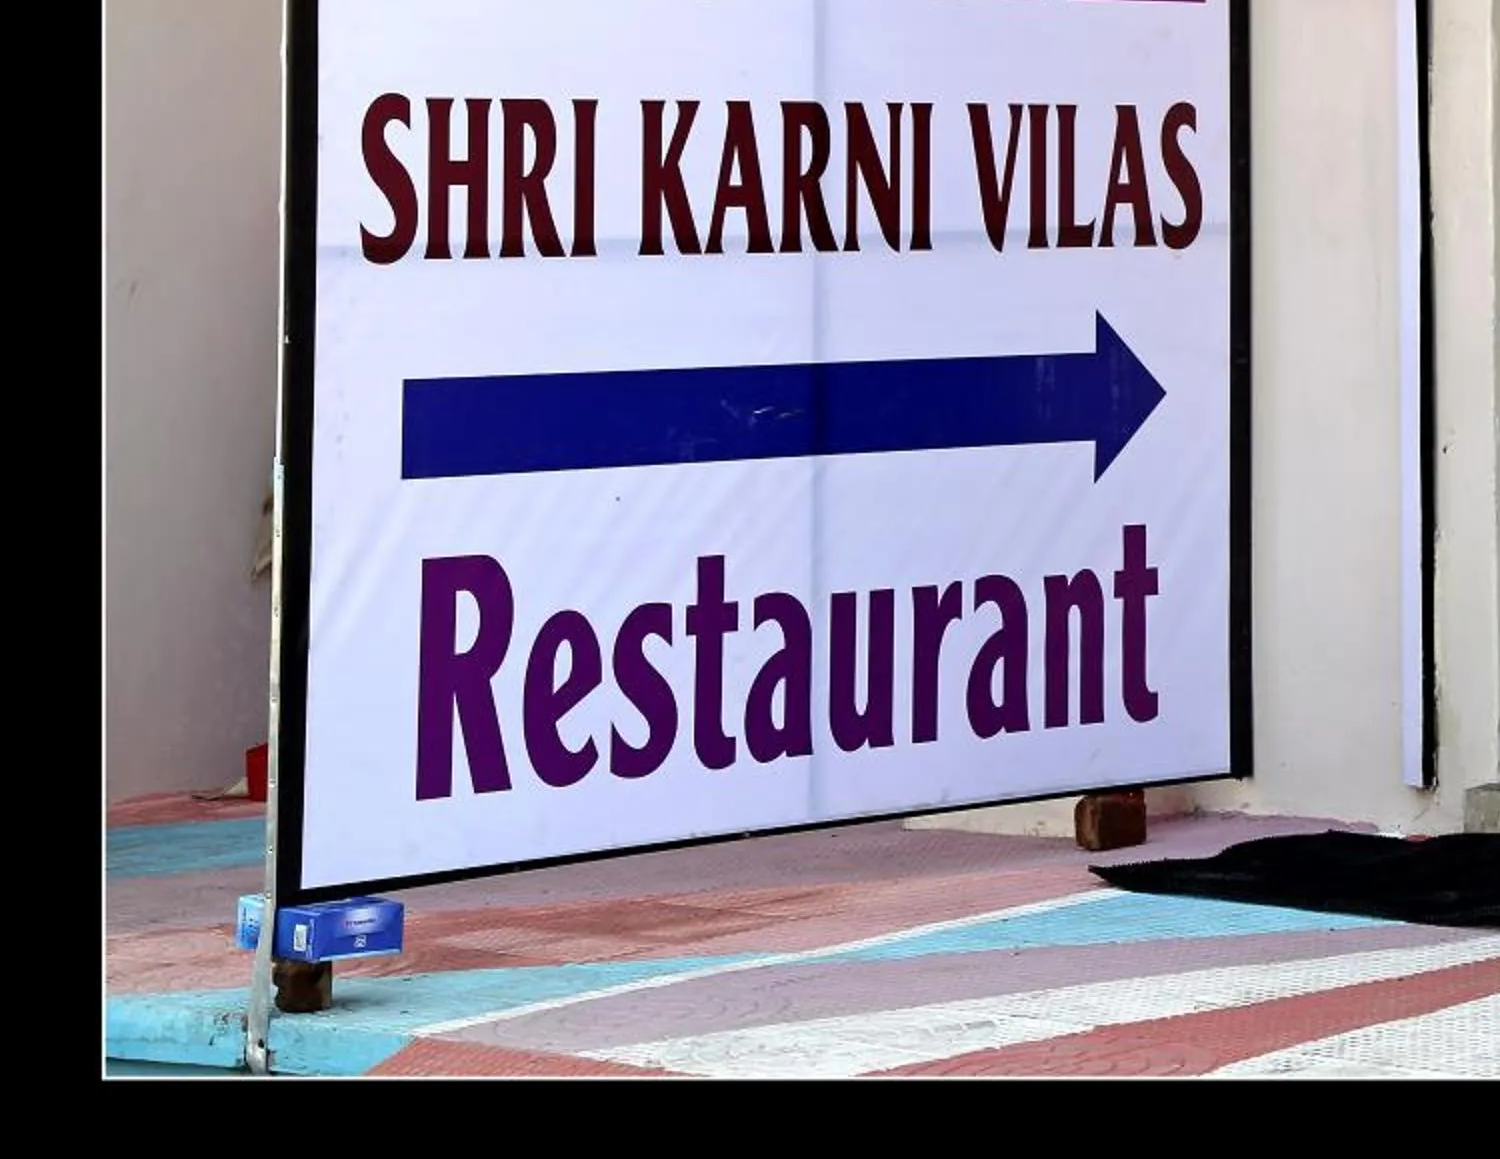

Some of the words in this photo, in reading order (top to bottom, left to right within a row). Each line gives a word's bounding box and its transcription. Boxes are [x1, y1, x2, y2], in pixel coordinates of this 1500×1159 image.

[359, 92, 599, 265] SHRI
[637, 99, 934, 256] KARNI
[966, 101, 1203, 253] VILAS
[415, 523, 1159, 801] Restaurant
